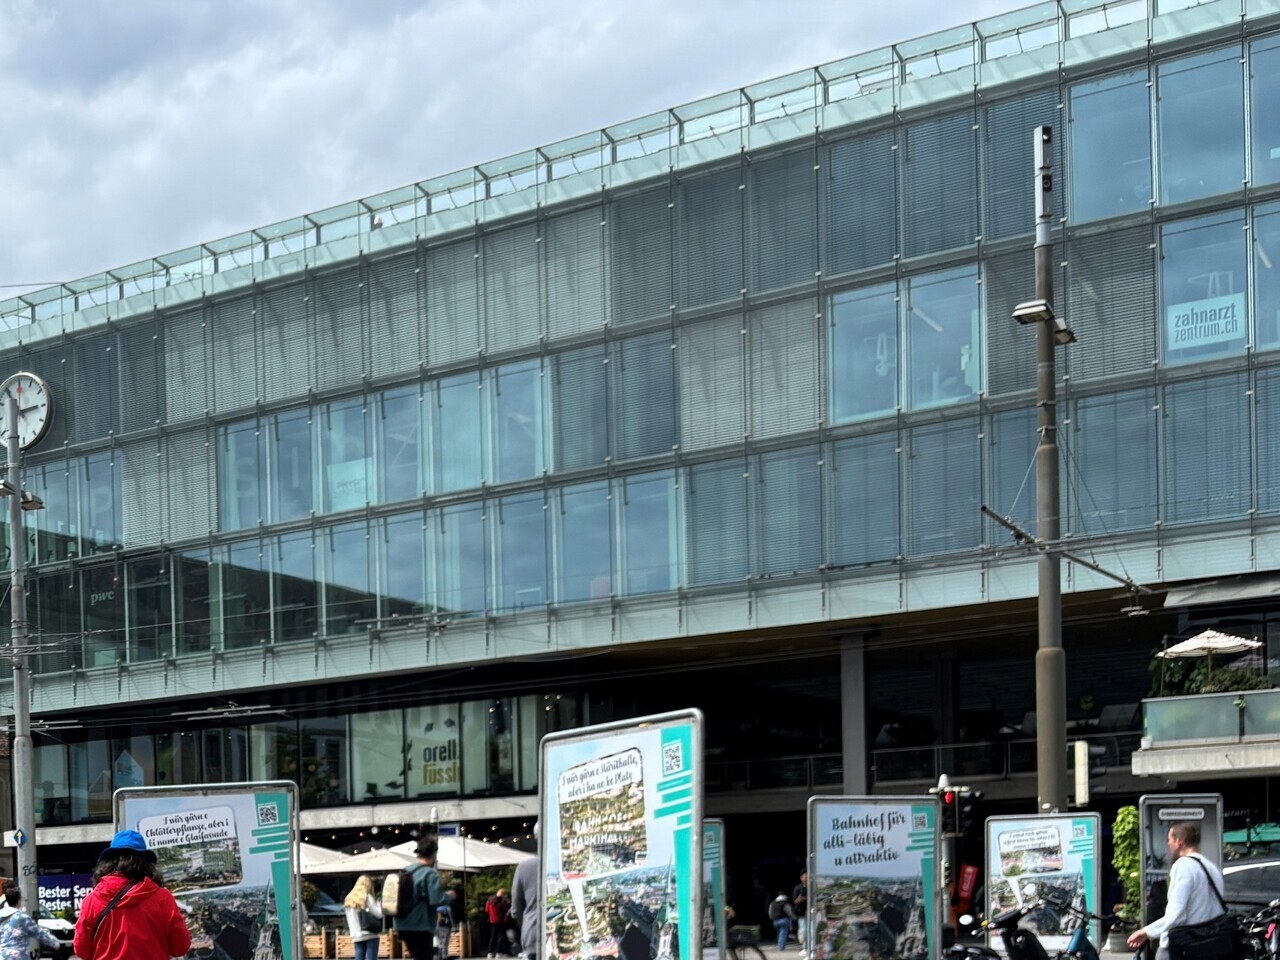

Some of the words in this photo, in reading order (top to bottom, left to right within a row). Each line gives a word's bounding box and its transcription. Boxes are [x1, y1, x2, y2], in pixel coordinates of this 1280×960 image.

[1175, 302, 1236, 328] zahnarzt
[1175, 319, 1238, 343] zentrum.ch
[90, 590, 115, 606] pwc
[423, 739, 457, 763] orell
[185, 813, 203, 824] gärn
[208, 819, 225, 829] aber
[832, 812, 884, 832] Bahnhof
[887, 811, 906, 831] für
[834, 857, 842, 866] u
[845, 848, 899, 865] attraktiv
[38, 886, 71, 898] Bester
